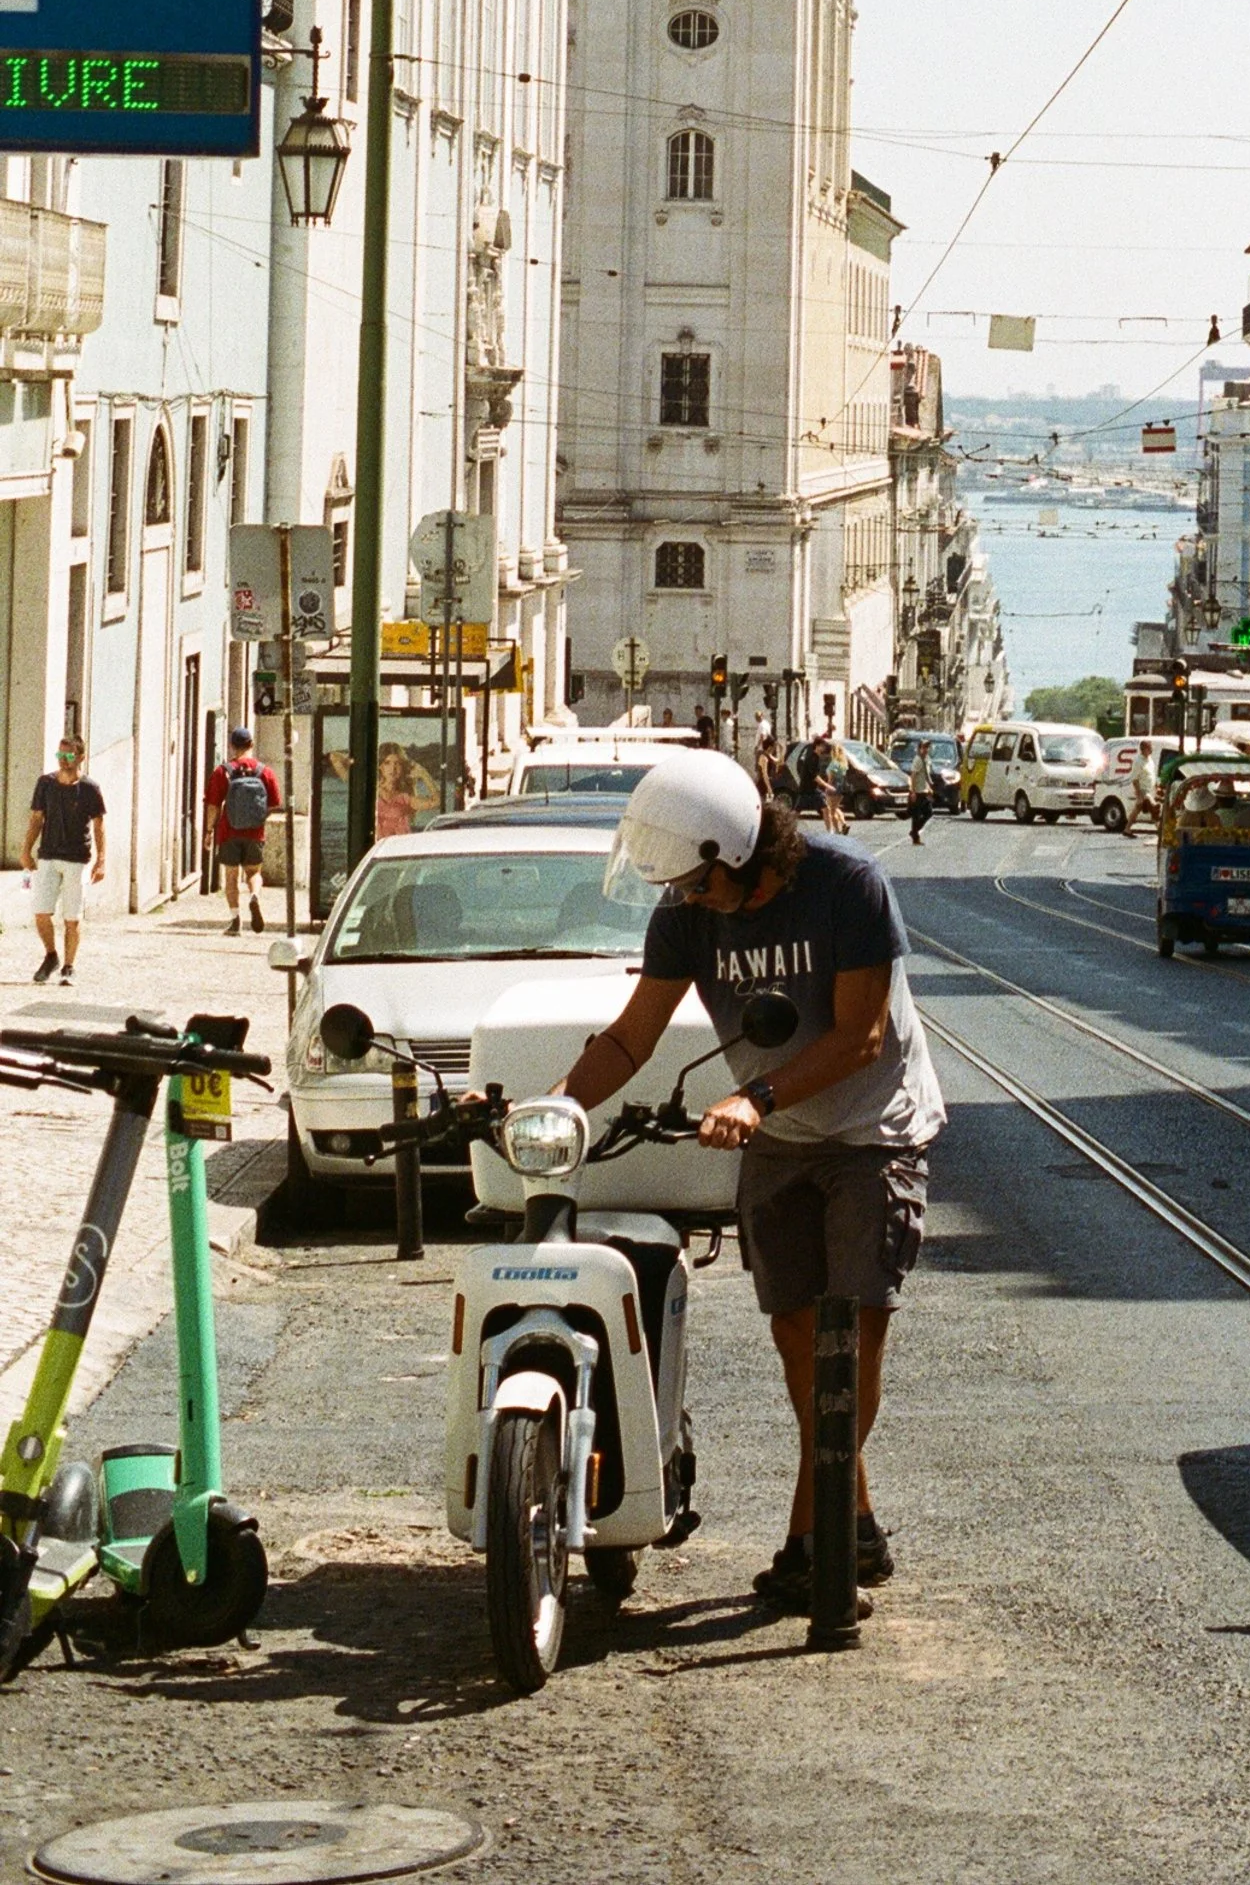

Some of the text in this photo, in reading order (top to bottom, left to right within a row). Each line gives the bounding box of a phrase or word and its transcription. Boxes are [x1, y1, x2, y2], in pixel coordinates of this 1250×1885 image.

[6, 58, 159, 107] IVRE
[716, 940, 812, 981] HAWAII
[169, 1141, 191, 1193] Bolt
